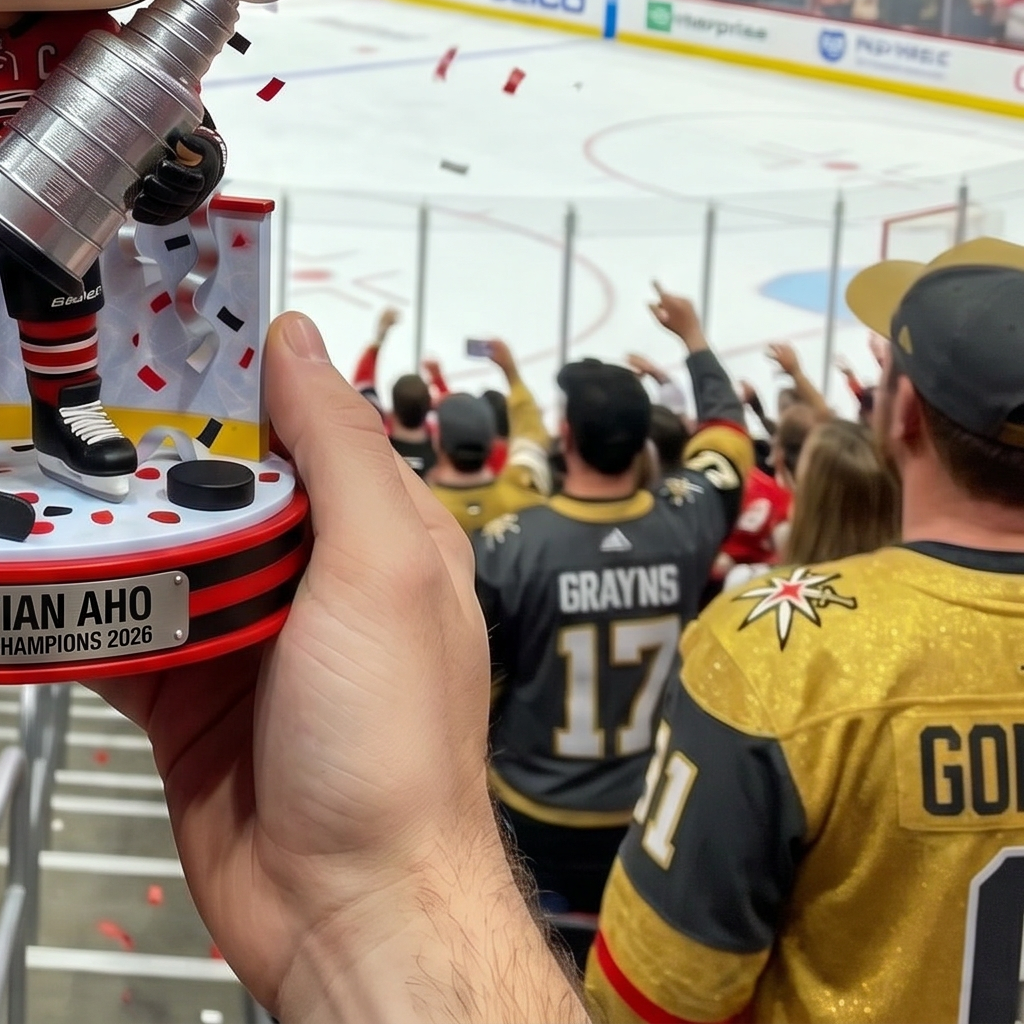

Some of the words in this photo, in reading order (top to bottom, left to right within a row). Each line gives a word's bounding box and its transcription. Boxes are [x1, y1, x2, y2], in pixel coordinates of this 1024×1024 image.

[76, 585, 153, 627] AHO
[558, 564, 681, 614] GRAYNS
[107, 625, 153, 649] 2026
[552, 613, 682, 761] 17
